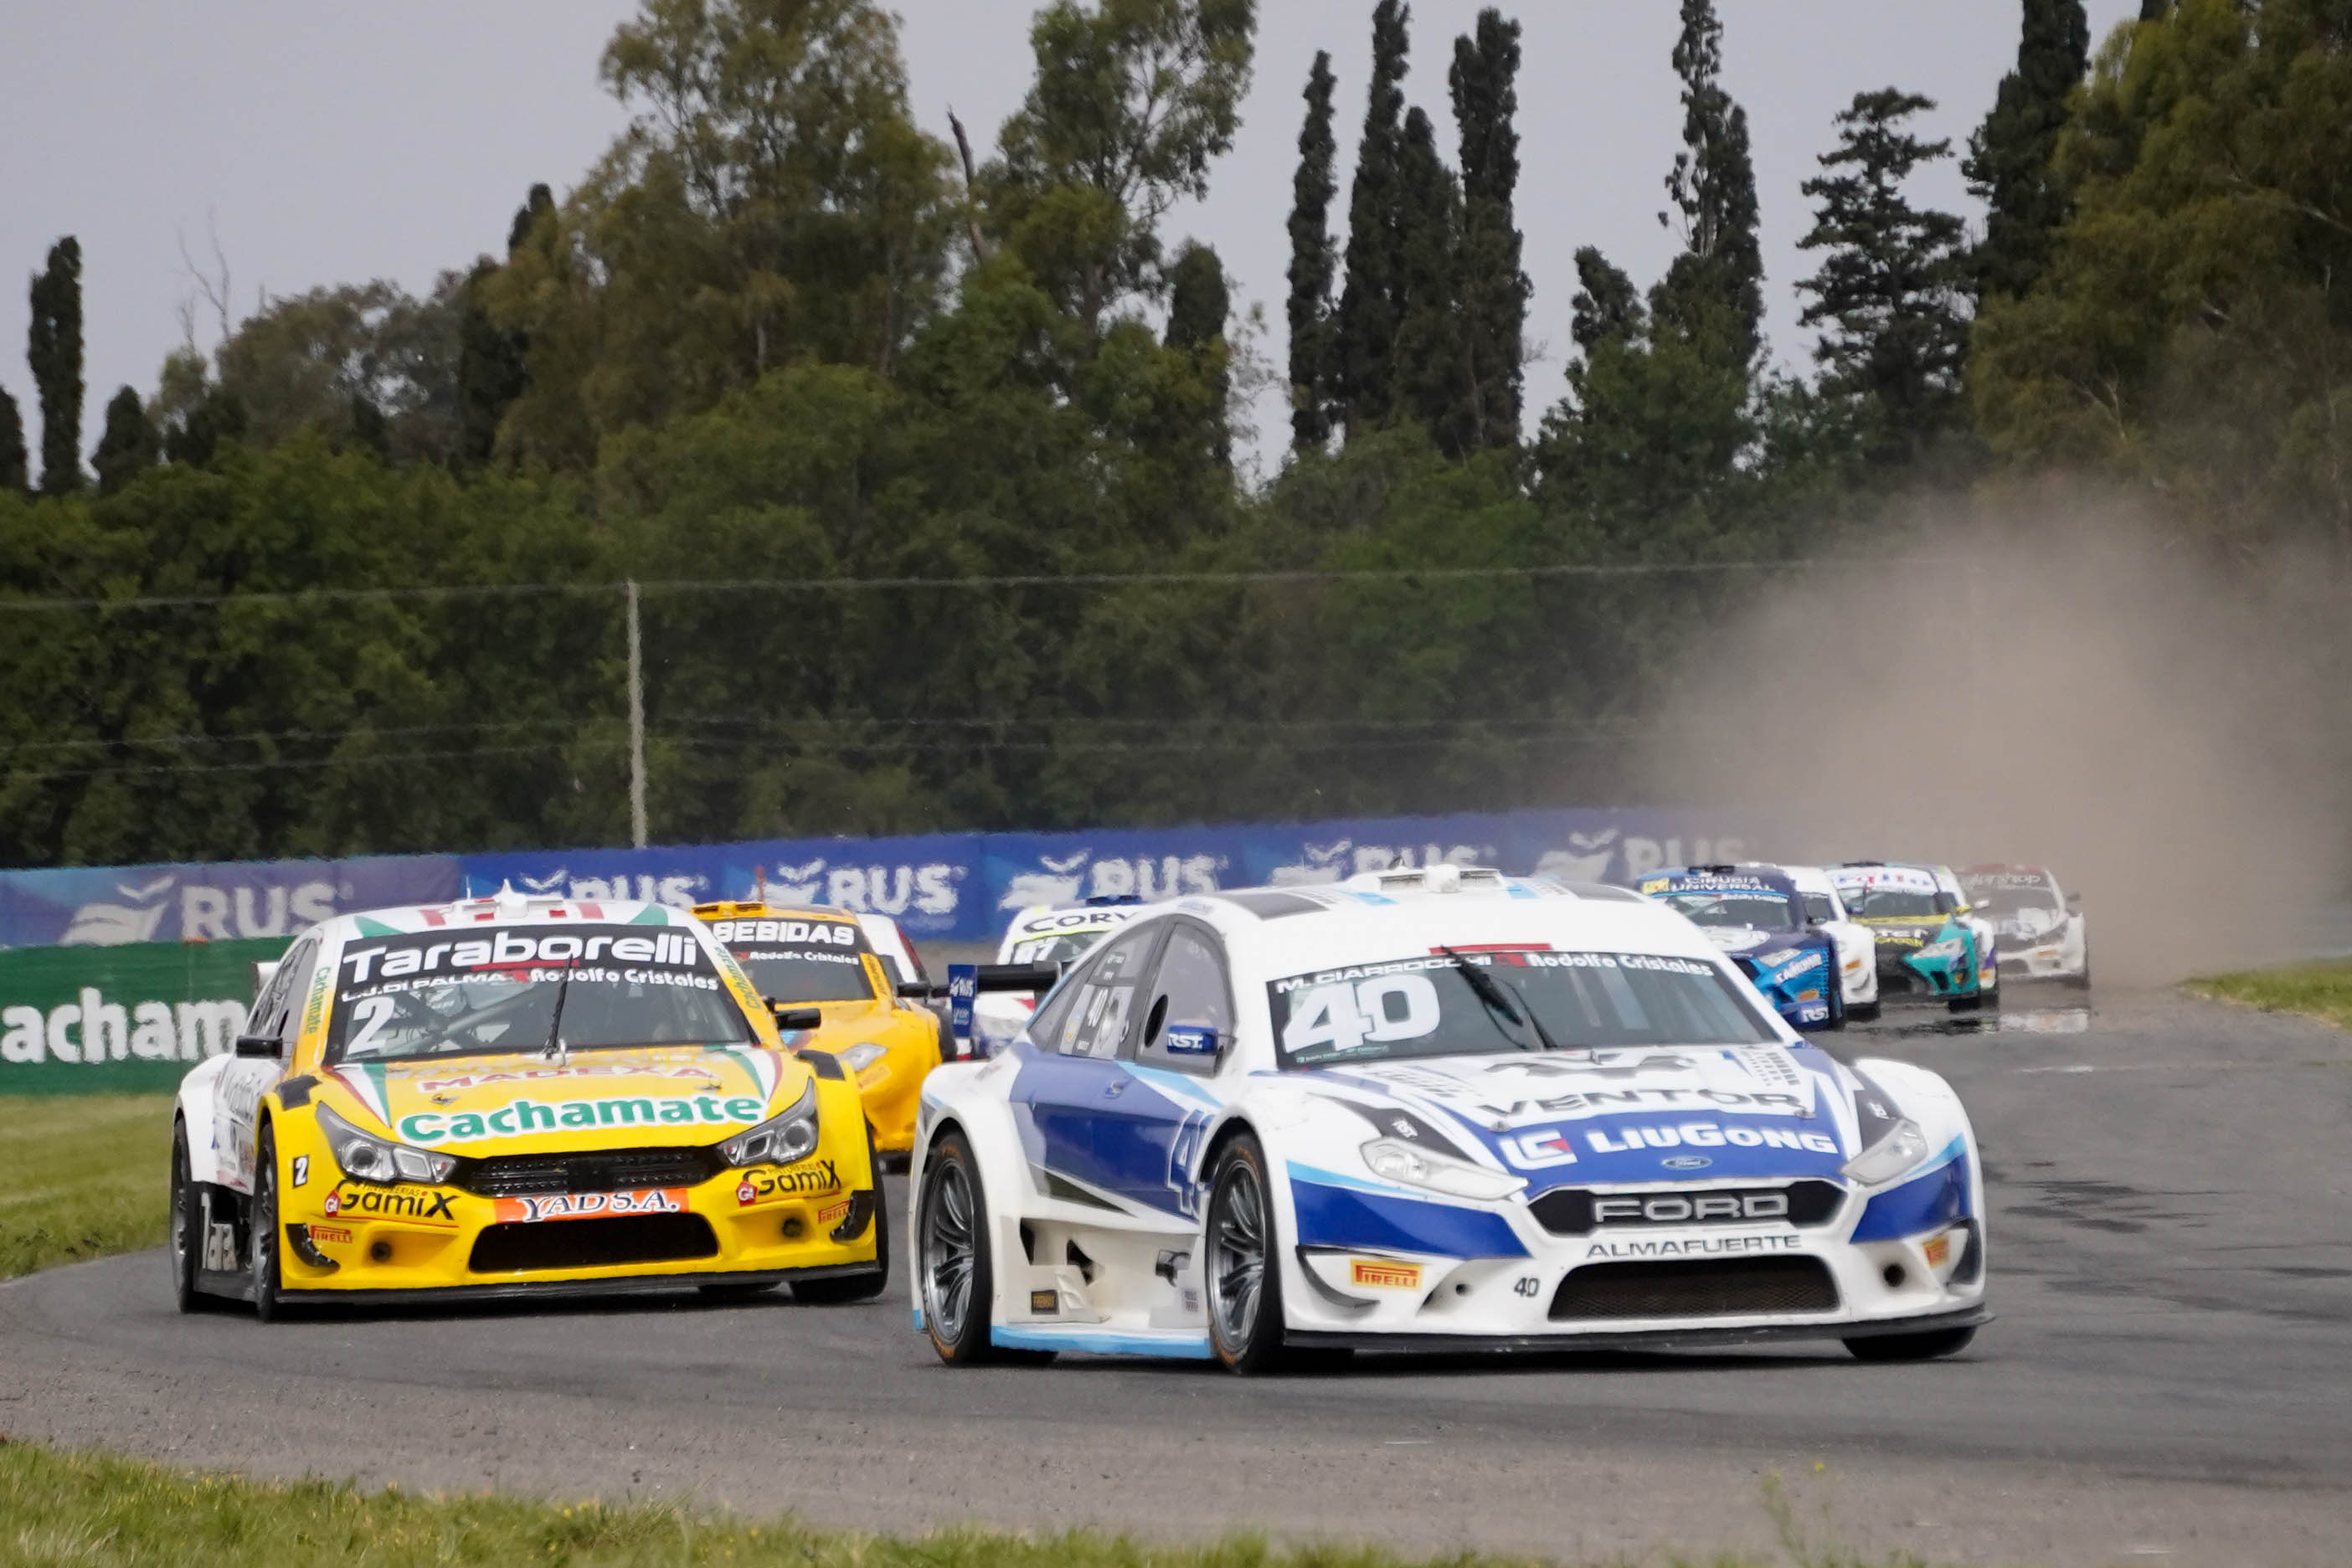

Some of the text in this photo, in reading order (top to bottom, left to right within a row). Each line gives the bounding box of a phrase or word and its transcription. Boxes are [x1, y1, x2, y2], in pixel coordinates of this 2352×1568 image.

[829, 864, 956, 914] RUS
[1093, 854, 1220, 900] RUS
[1670, 883, 1776, 892] UNIVERSAL
[181, 882, 337, 939] RUS
[713, 921, 855, 946] BEBIDAS
[343, 931, 696, 984] Taraborelli
[749, 950, 860, 965] Rodolfo Cristales
[1526, 952, 1715, 977] Rodolfo Cristales
[412, 972, 507, 990] PALMA
[624, 967, 719, 991] Cristales
[305, 966, 332, 1036] Cachamate
[1282, 974, 1441, 1054] 40
[1, 987, 249, 1063] acham
[347, 996, 395, 1056] 2
[400, 1094, 764, 1141] Cachamate
[1475, 1088, 1807, 1118] VENTOR
[295, 1156, 308, 1185] 2
[521, 1194, 605, 1222] YAD
[1595, 1193, 1788, 1223] FORD
[311, 1226, 353, 1244] PIRELLI
[1587, 1234, 1803, 1258] ALMAFUERTE
[1355, 1265, 1418, 1288] PIRELLI
[1514, 1277, 1541, 1298] 40
